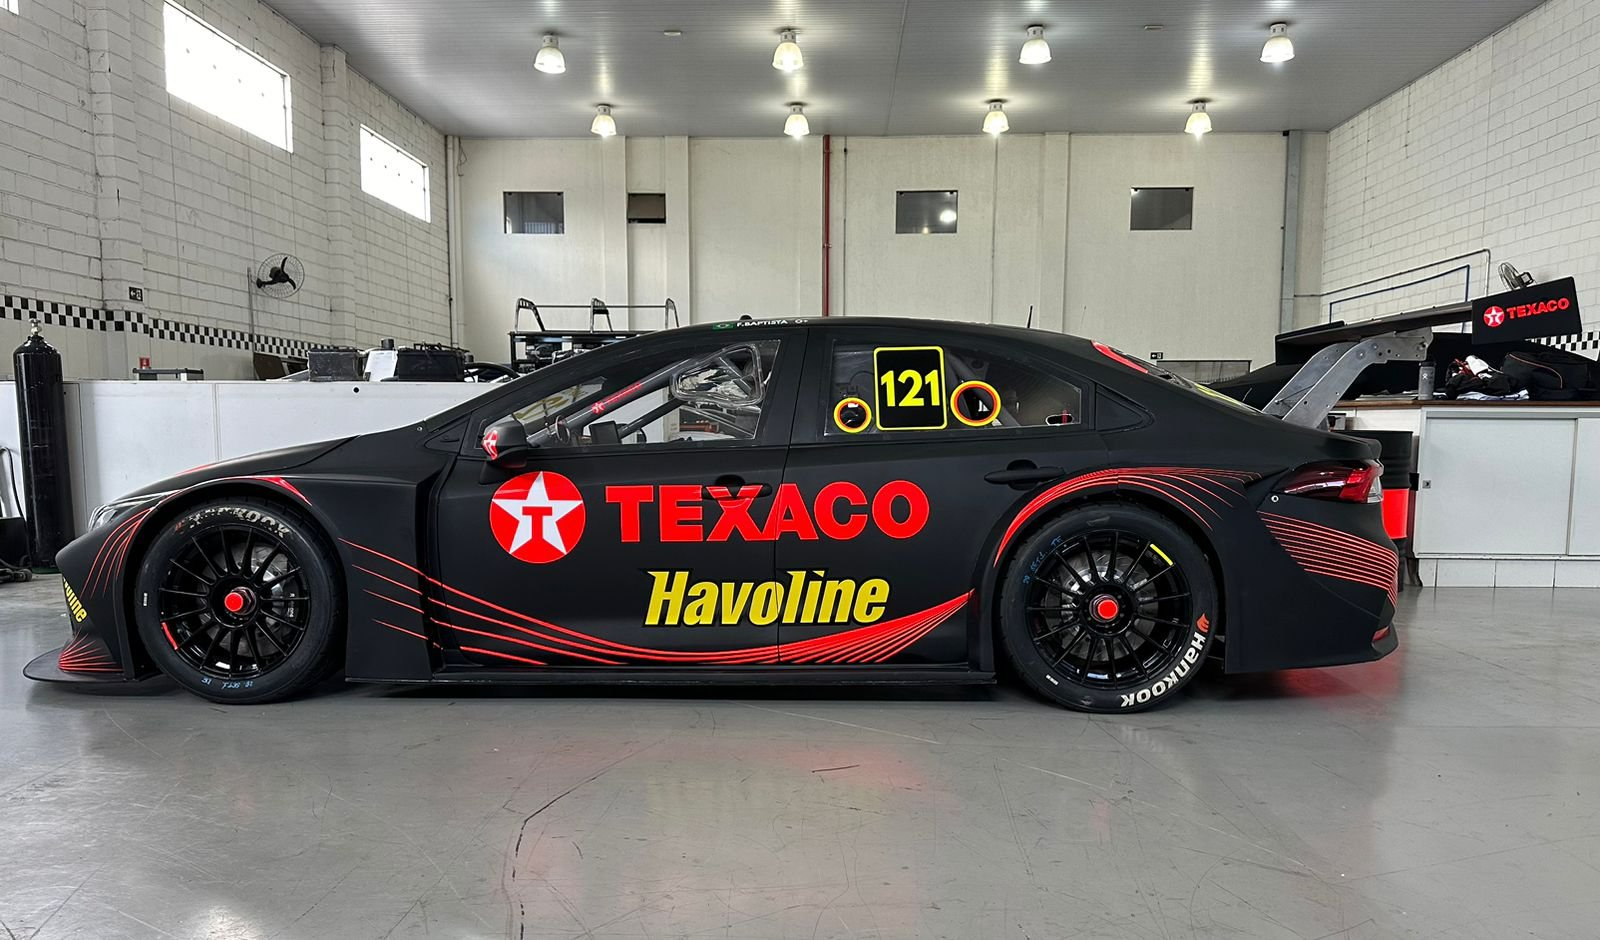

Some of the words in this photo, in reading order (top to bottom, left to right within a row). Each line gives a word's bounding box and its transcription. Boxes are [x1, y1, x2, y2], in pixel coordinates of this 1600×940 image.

[1506, 298, 1569, 319] TEXACO
[880, 369, 940, 407] 121
[605, 480, 930, 542] TEXACO
[645, 570, 889, 625] Havoline
